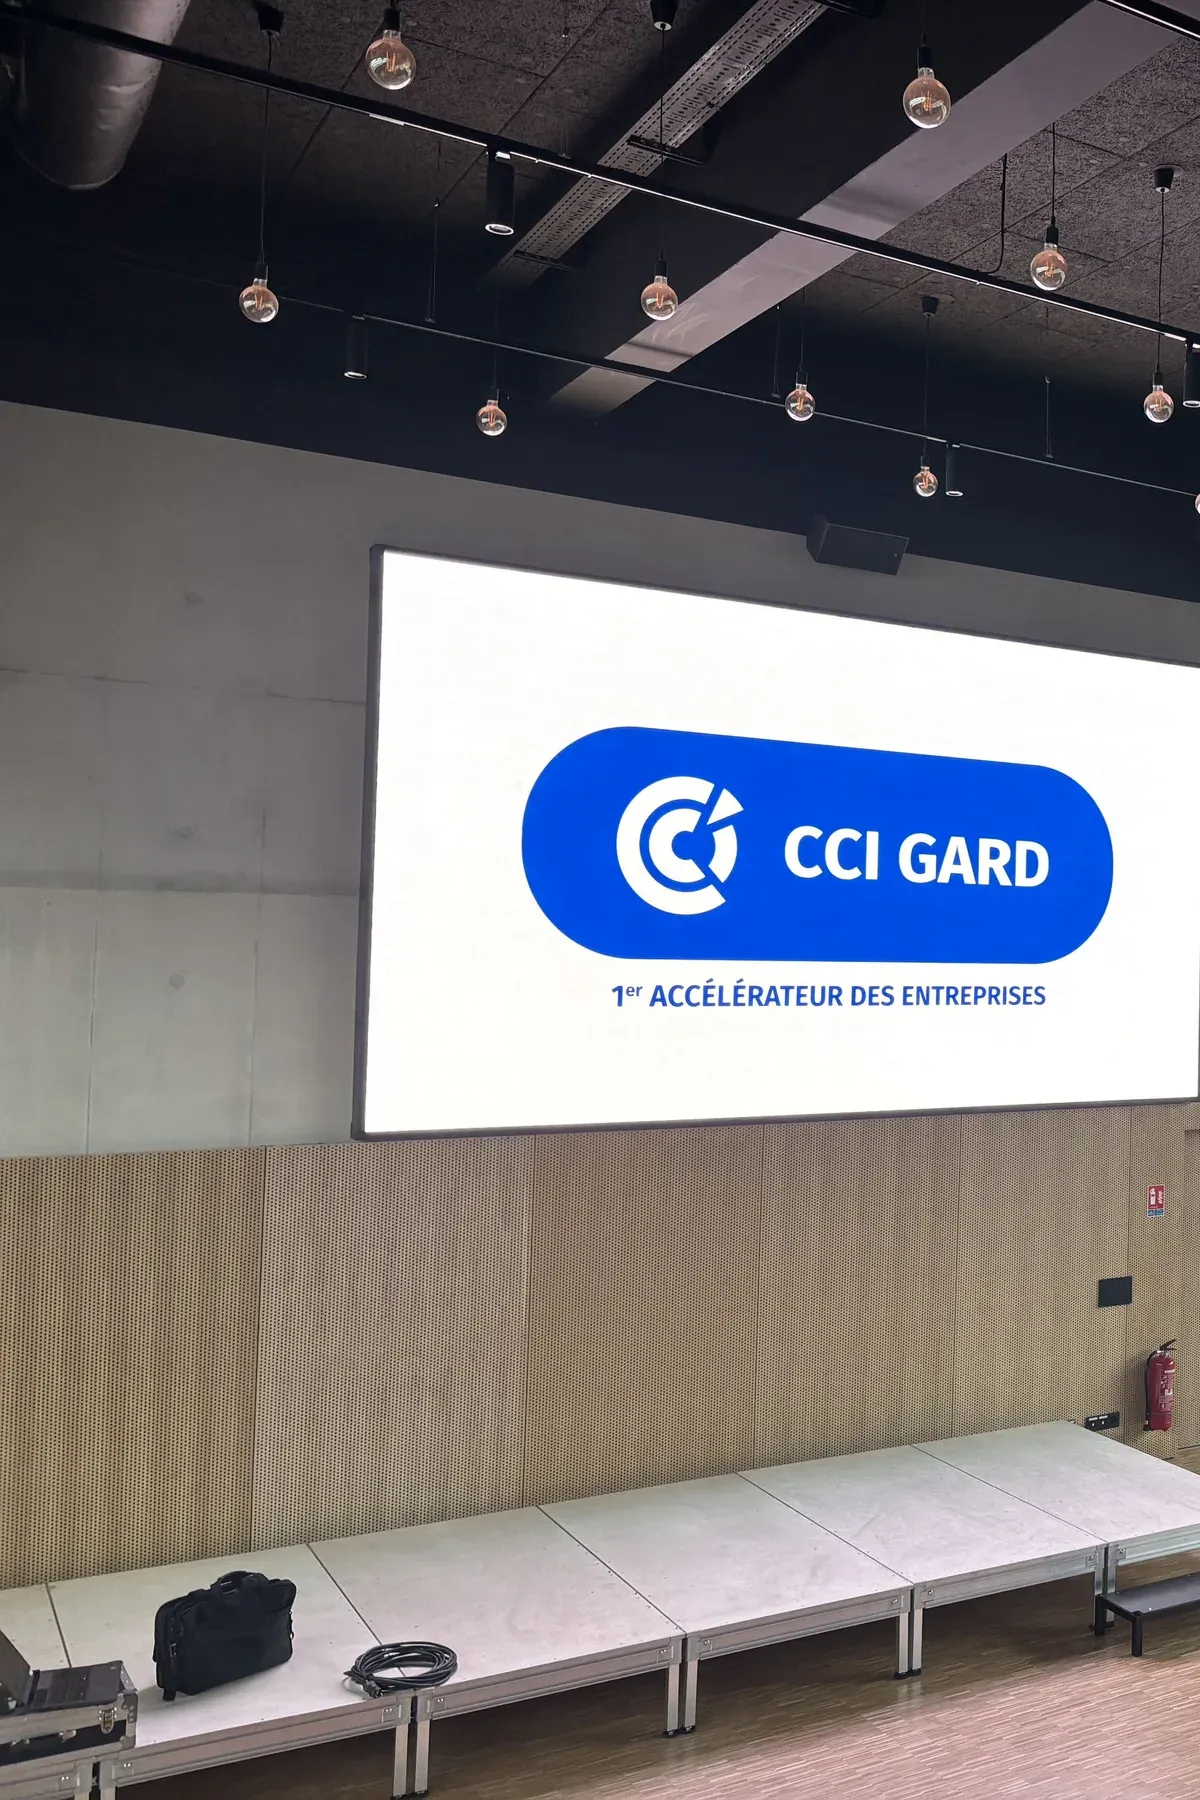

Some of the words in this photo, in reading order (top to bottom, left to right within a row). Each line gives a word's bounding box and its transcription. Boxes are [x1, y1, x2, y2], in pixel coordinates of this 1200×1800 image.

[784, 825, 879, 880] CCI
[899, 833, 1050, 888] GARD
[611, 982, 643, 1007] 1er
[649, 977, 843, 1007] ACCÉLÉRATEUR
[850, 984, 895, 1007] DES
[902, 985, 1047, 1006] ENTREPRISES
